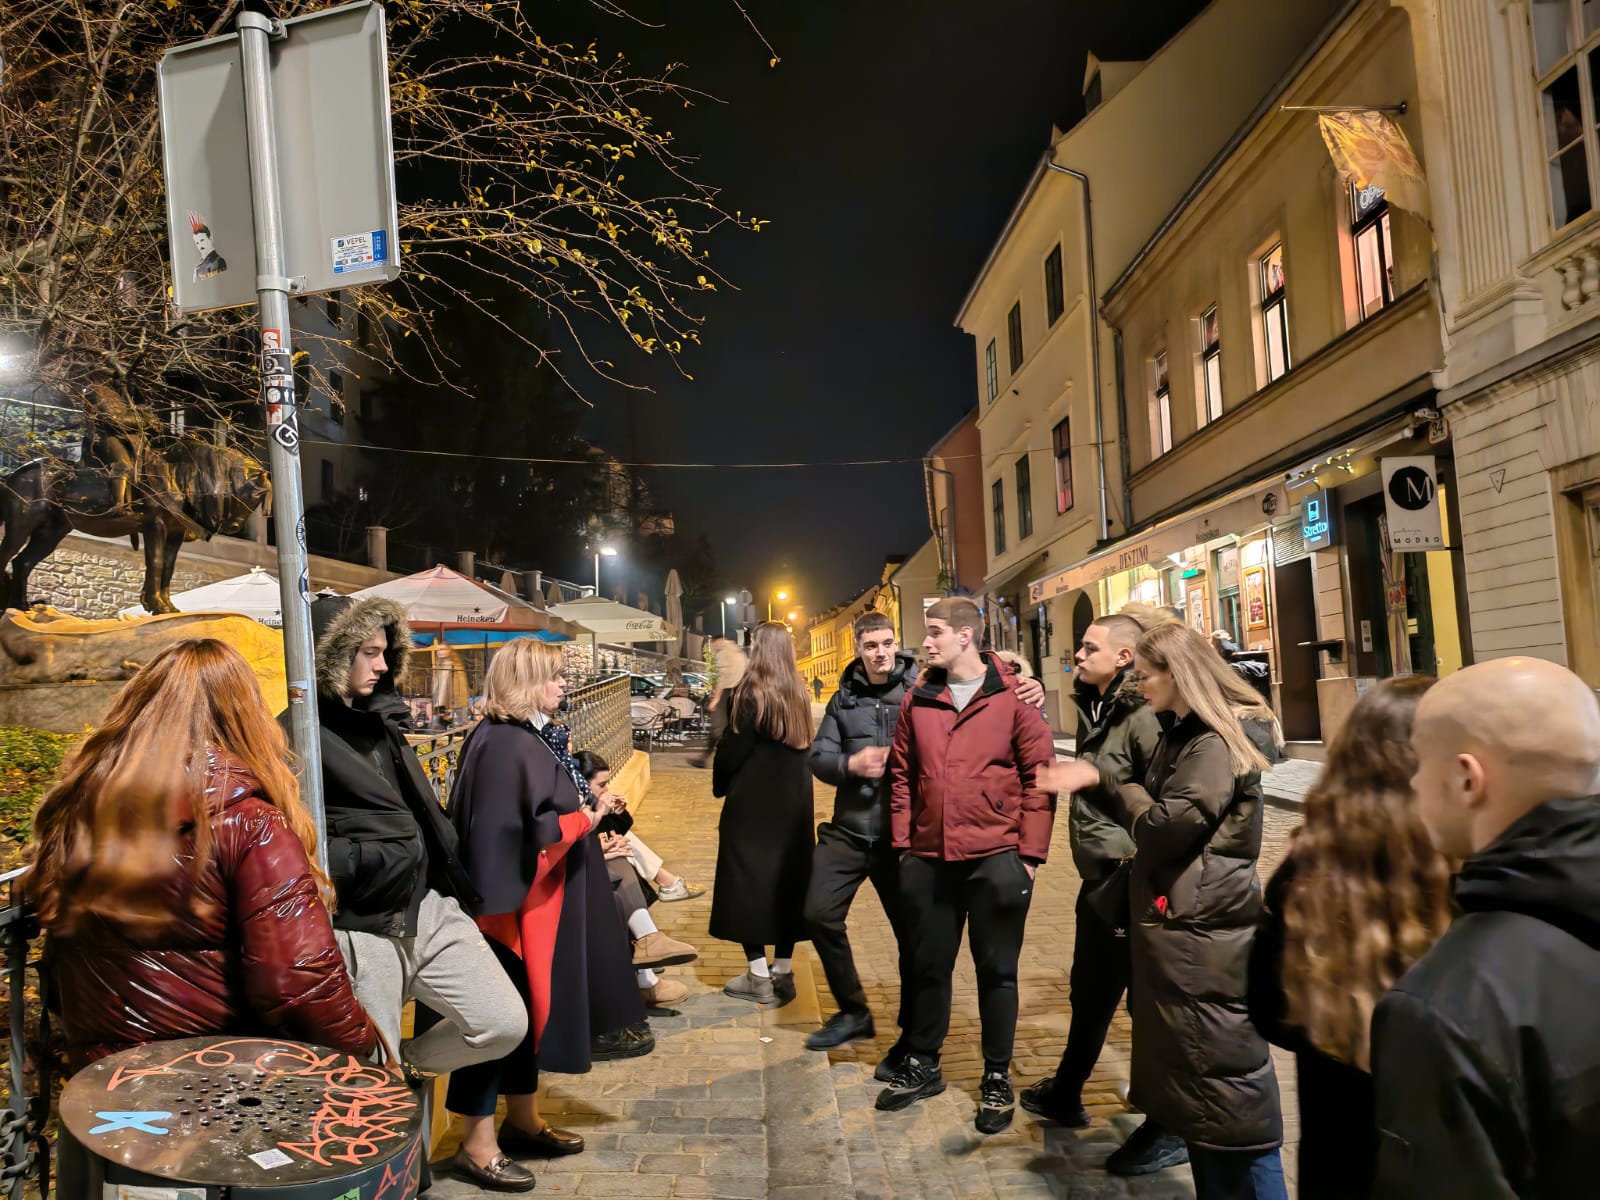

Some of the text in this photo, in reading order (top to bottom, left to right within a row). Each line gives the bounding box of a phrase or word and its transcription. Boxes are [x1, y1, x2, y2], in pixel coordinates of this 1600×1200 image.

[1304, 521, 1328, 538] Stretto
[1119, 544, 1149, 570] DESTINO
[456, 614, 496, 623] Heineken
